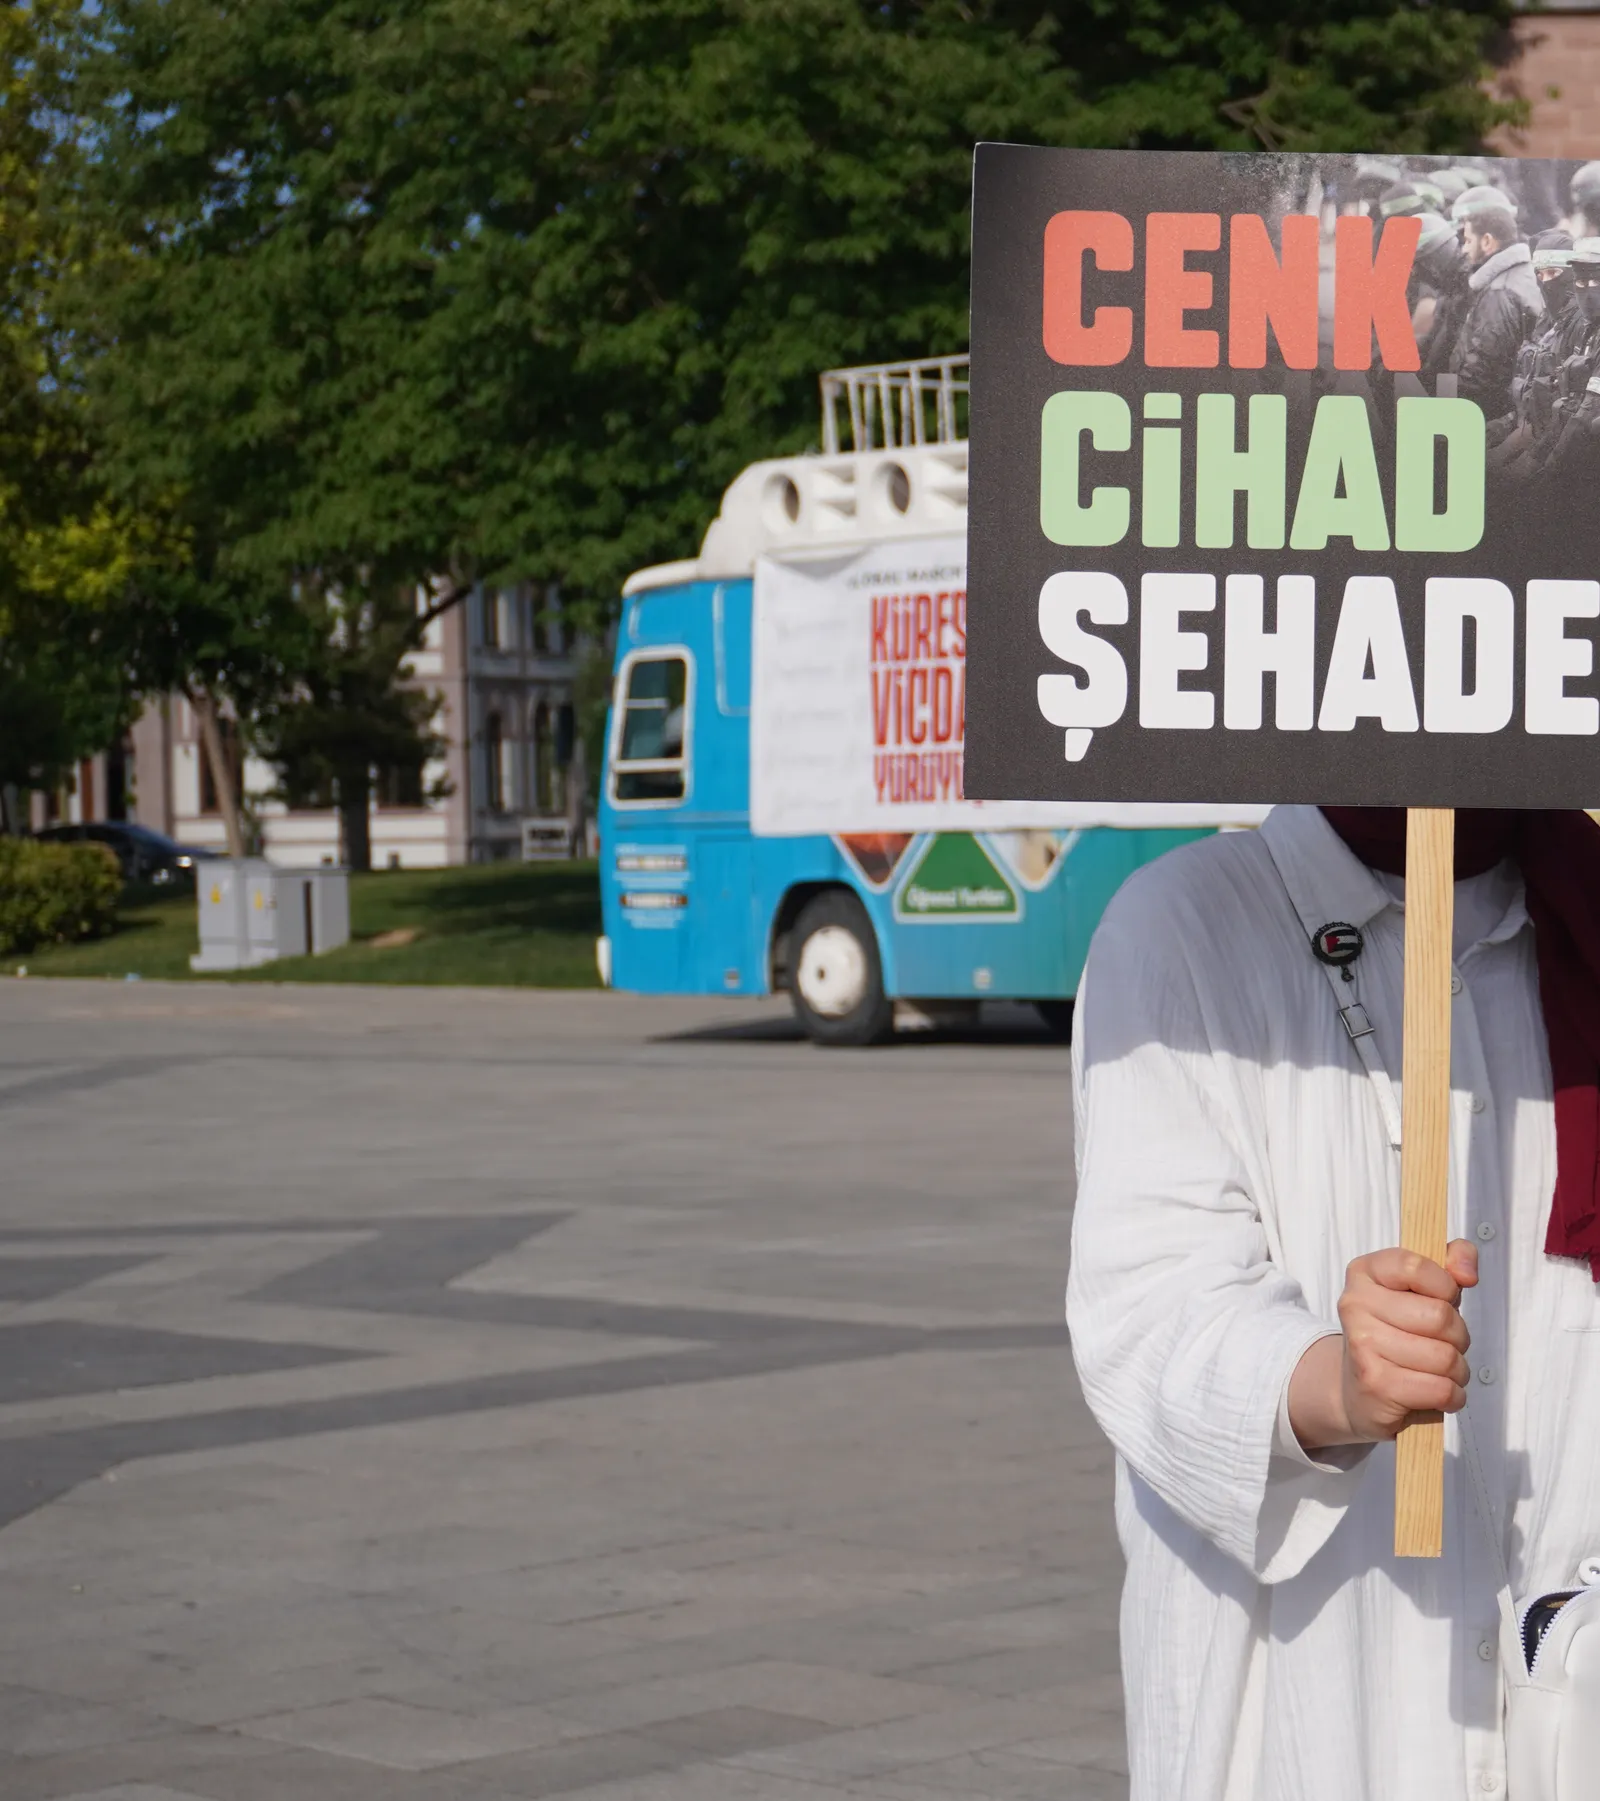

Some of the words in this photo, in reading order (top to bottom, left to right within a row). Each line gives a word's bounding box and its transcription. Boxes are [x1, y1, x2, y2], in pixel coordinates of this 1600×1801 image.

[1042, 210, 1421, 371] CENK
[1040, 391, 1485, 552] CİHAD
[871, 590, 966, 663] KÜRES
